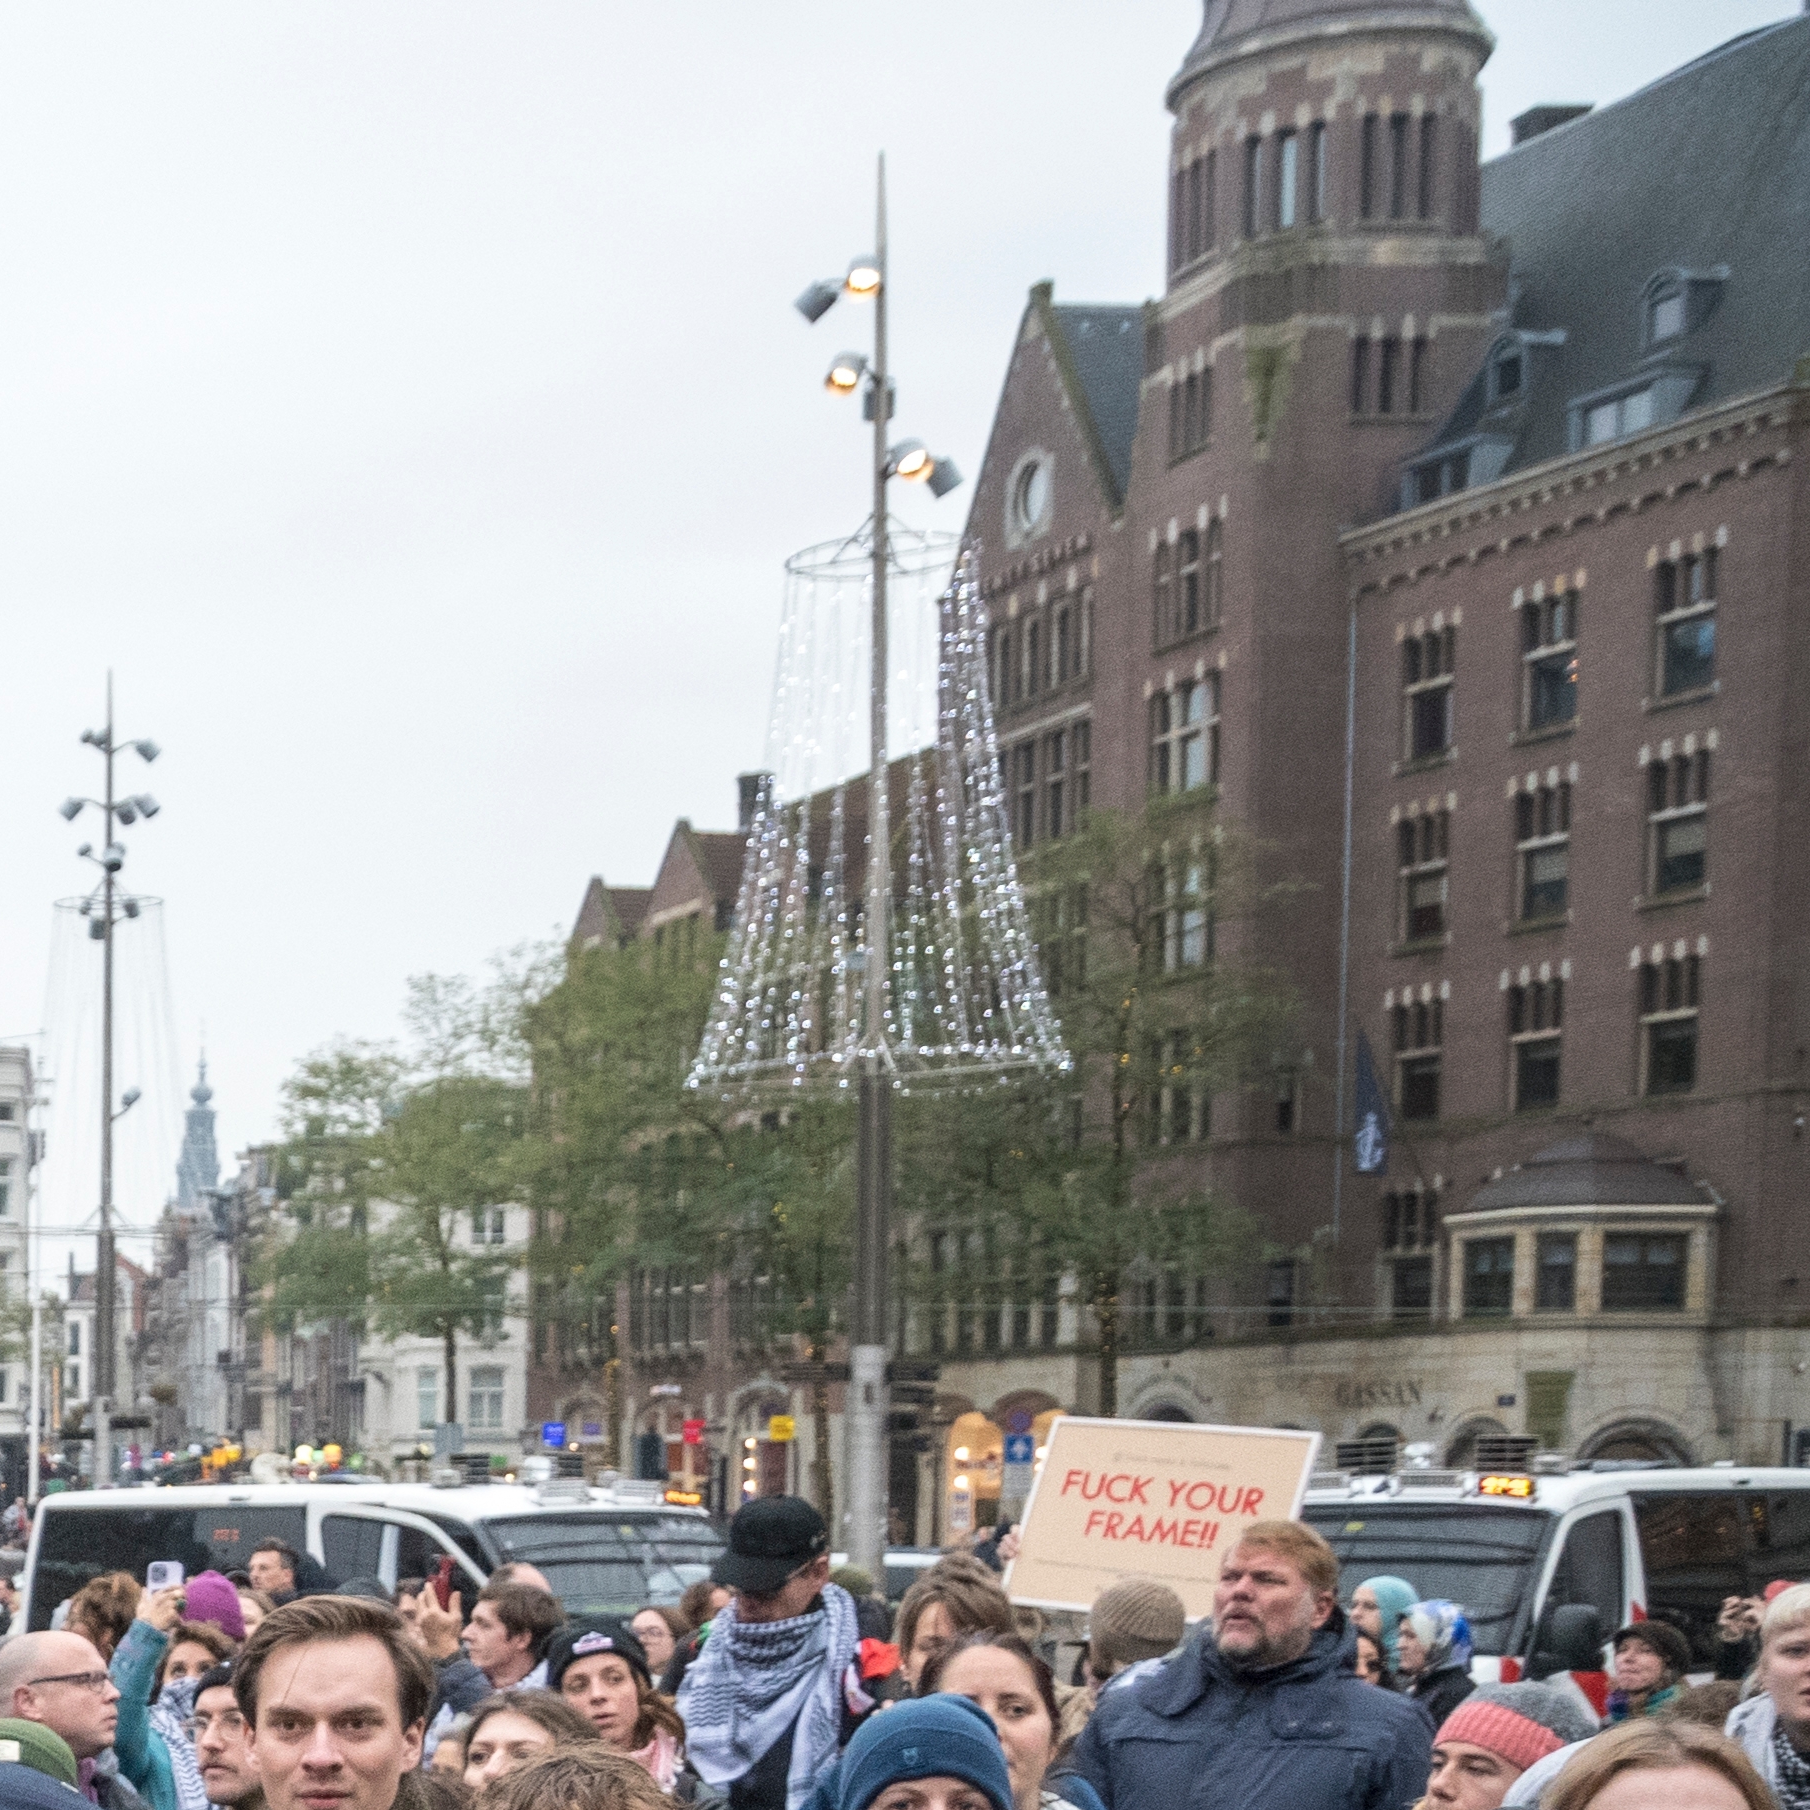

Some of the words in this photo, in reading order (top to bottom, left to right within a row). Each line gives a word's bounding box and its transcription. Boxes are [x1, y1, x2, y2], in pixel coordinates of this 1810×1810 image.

[1060, 1468, 1155, 1506] FUCK
[1168, 1478, 1266, 1516] YOUR
[1083, 1509, 1220, 1550] FRAME!!
